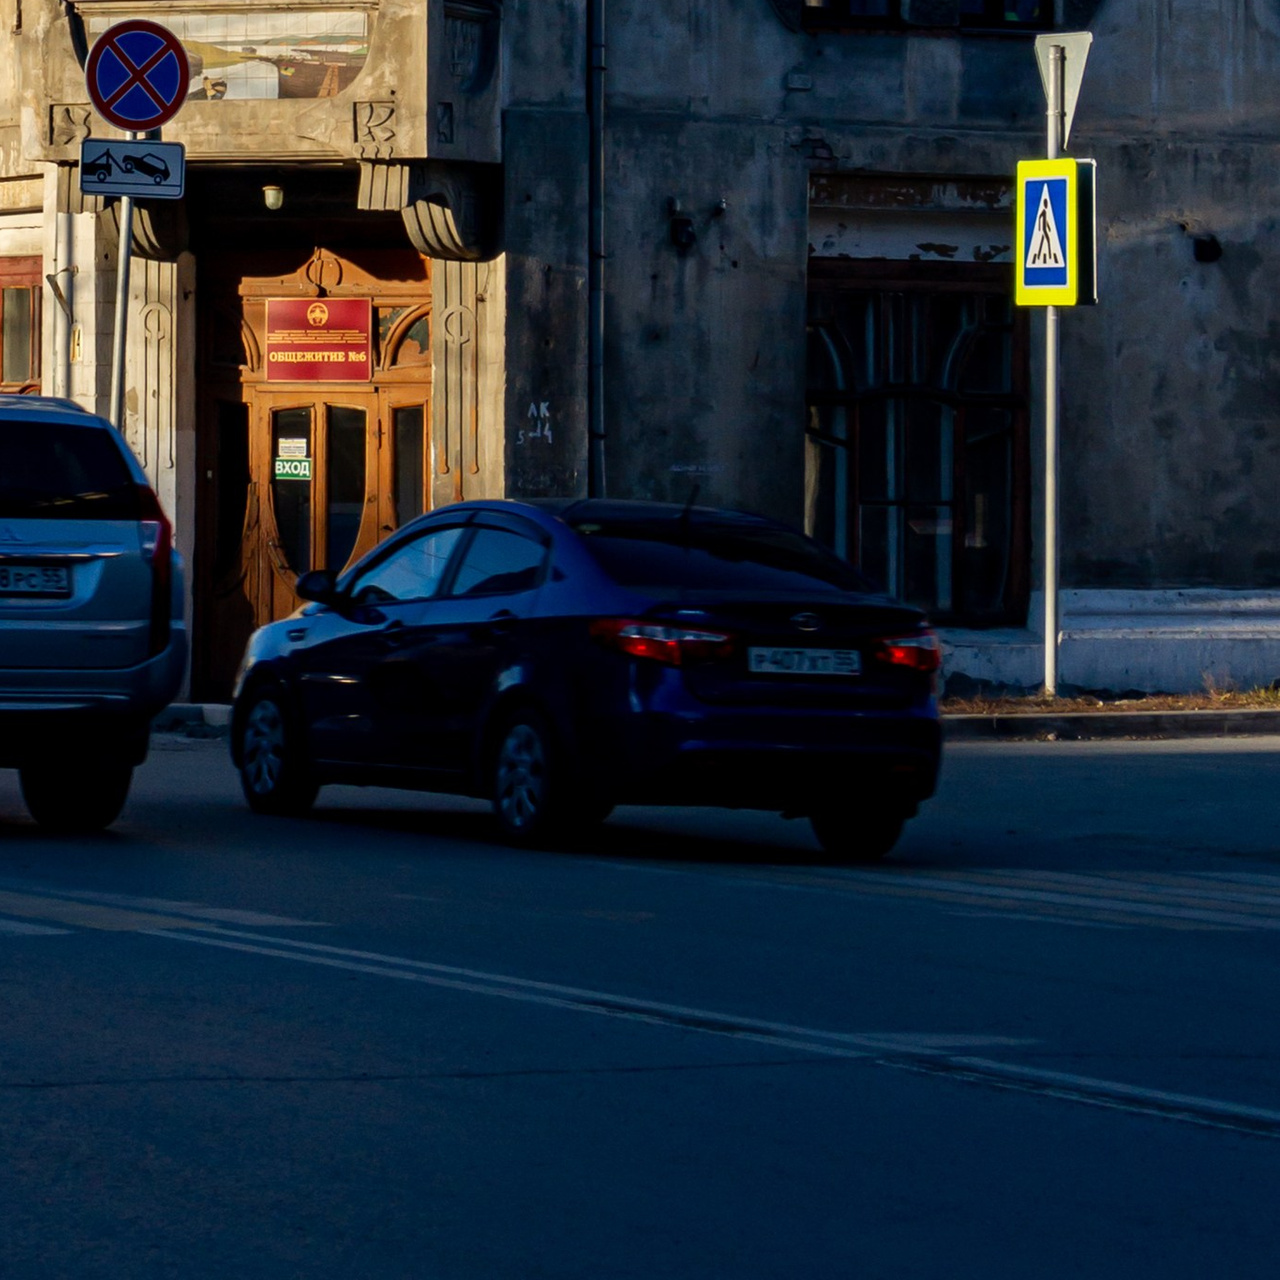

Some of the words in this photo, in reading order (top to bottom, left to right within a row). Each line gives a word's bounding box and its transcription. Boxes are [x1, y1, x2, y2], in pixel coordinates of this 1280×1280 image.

[269, 351, 346, 364] ОБЩЕЖИТИЕ
[348, 351, 367, 362] №6
[275, 461, 310, 477] ВХОД
